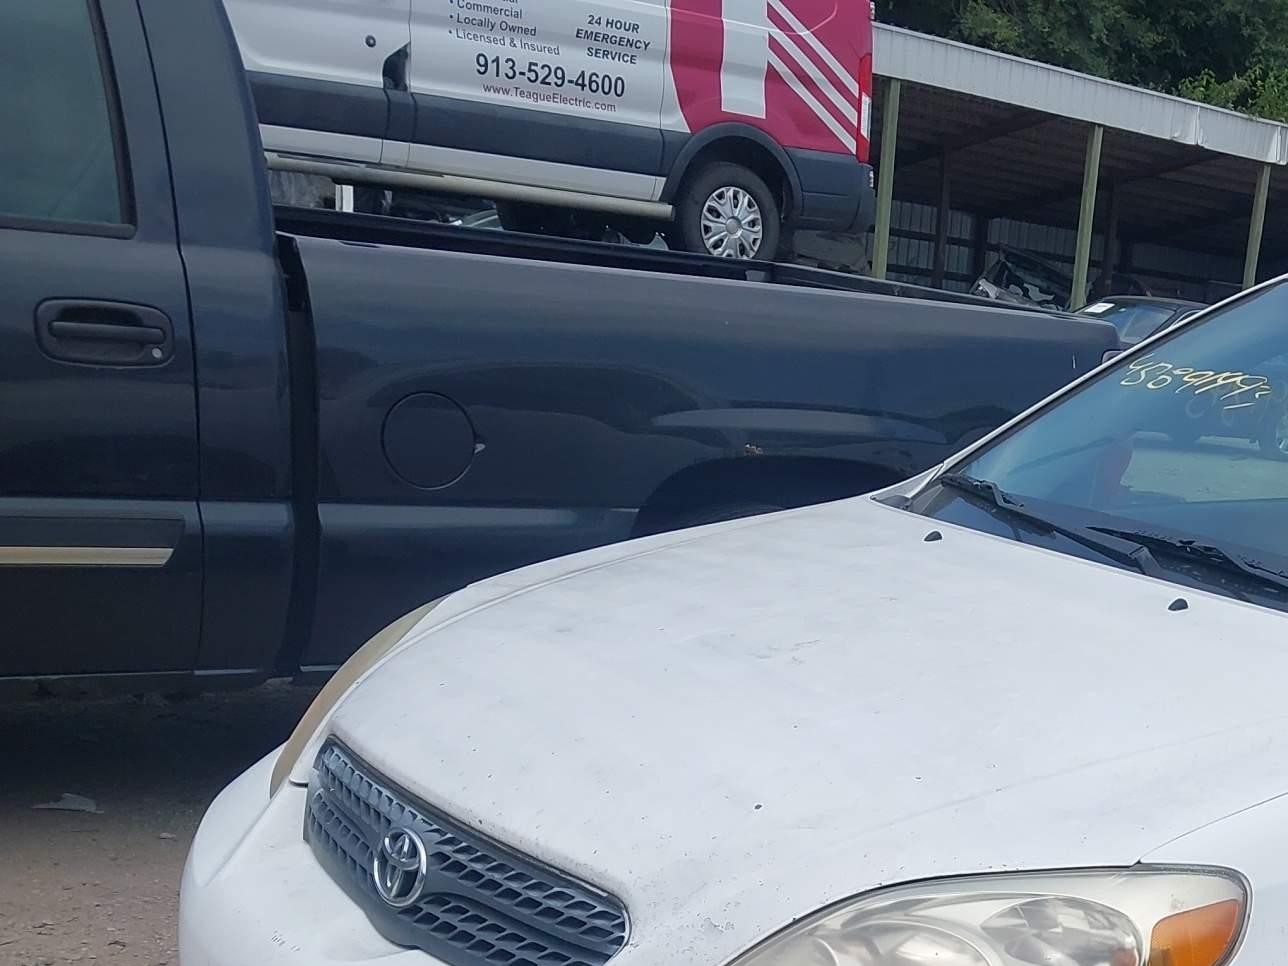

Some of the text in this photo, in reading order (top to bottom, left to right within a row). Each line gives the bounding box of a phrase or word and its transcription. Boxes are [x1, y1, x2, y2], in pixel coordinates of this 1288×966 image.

[457, 0, 522, 19] Commercial
[456, 13, 537, 36] Locally Owned
[588, 14, 640, 33] 24 HOUR
[456, 28, 560, 56] Licensed & Insured
[575, 28, 650, 50] EMERGENCY
[587, 47, 637, 64] SERVICE
[476, 53, 625, 97] 913-529-4600
[483, 83, 616, 112] www.TeagueElectric.com
